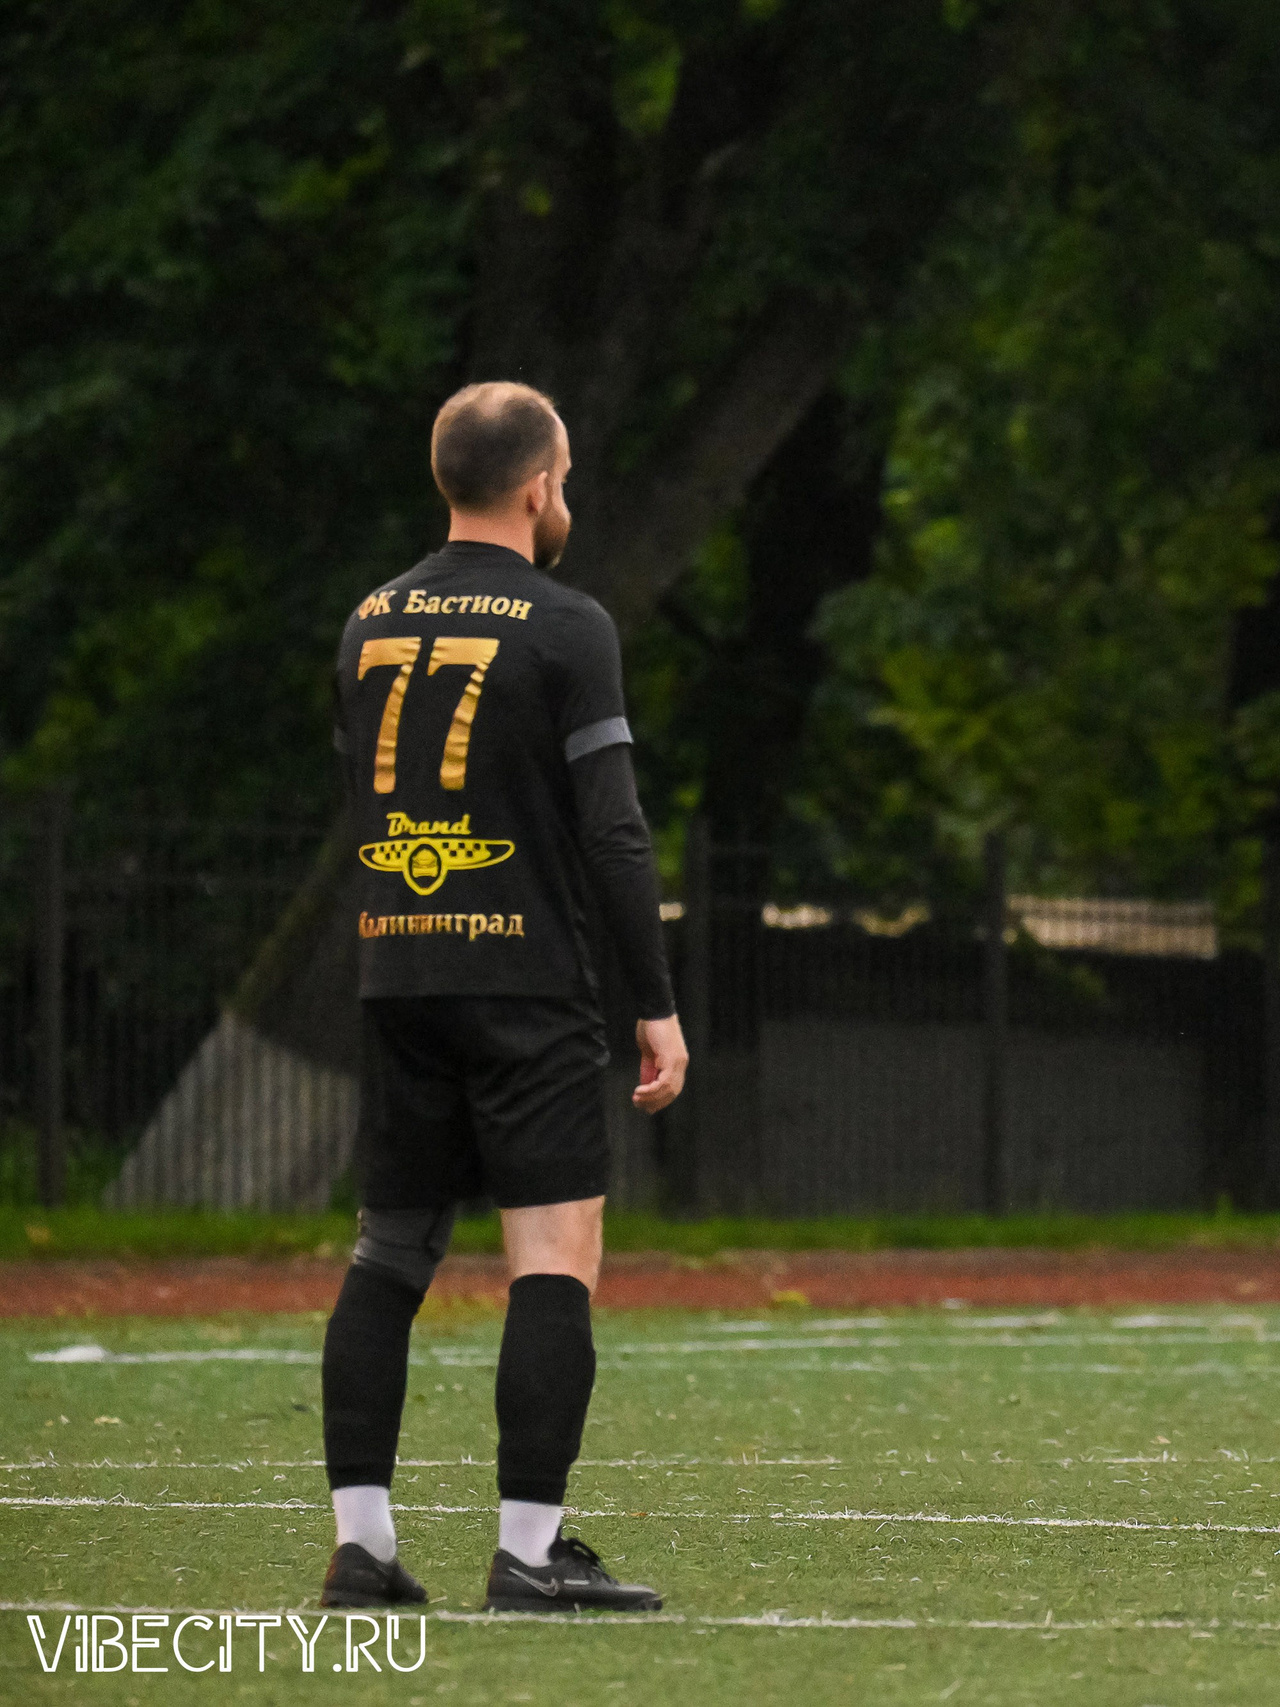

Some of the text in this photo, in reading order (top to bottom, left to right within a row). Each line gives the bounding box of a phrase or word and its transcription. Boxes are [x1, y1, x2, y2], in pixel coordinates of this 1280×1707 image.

[403, 589, 533, 620] Бастион
[358, 637, 499, 794] 77
[386, 811, 472, 837] Brand
